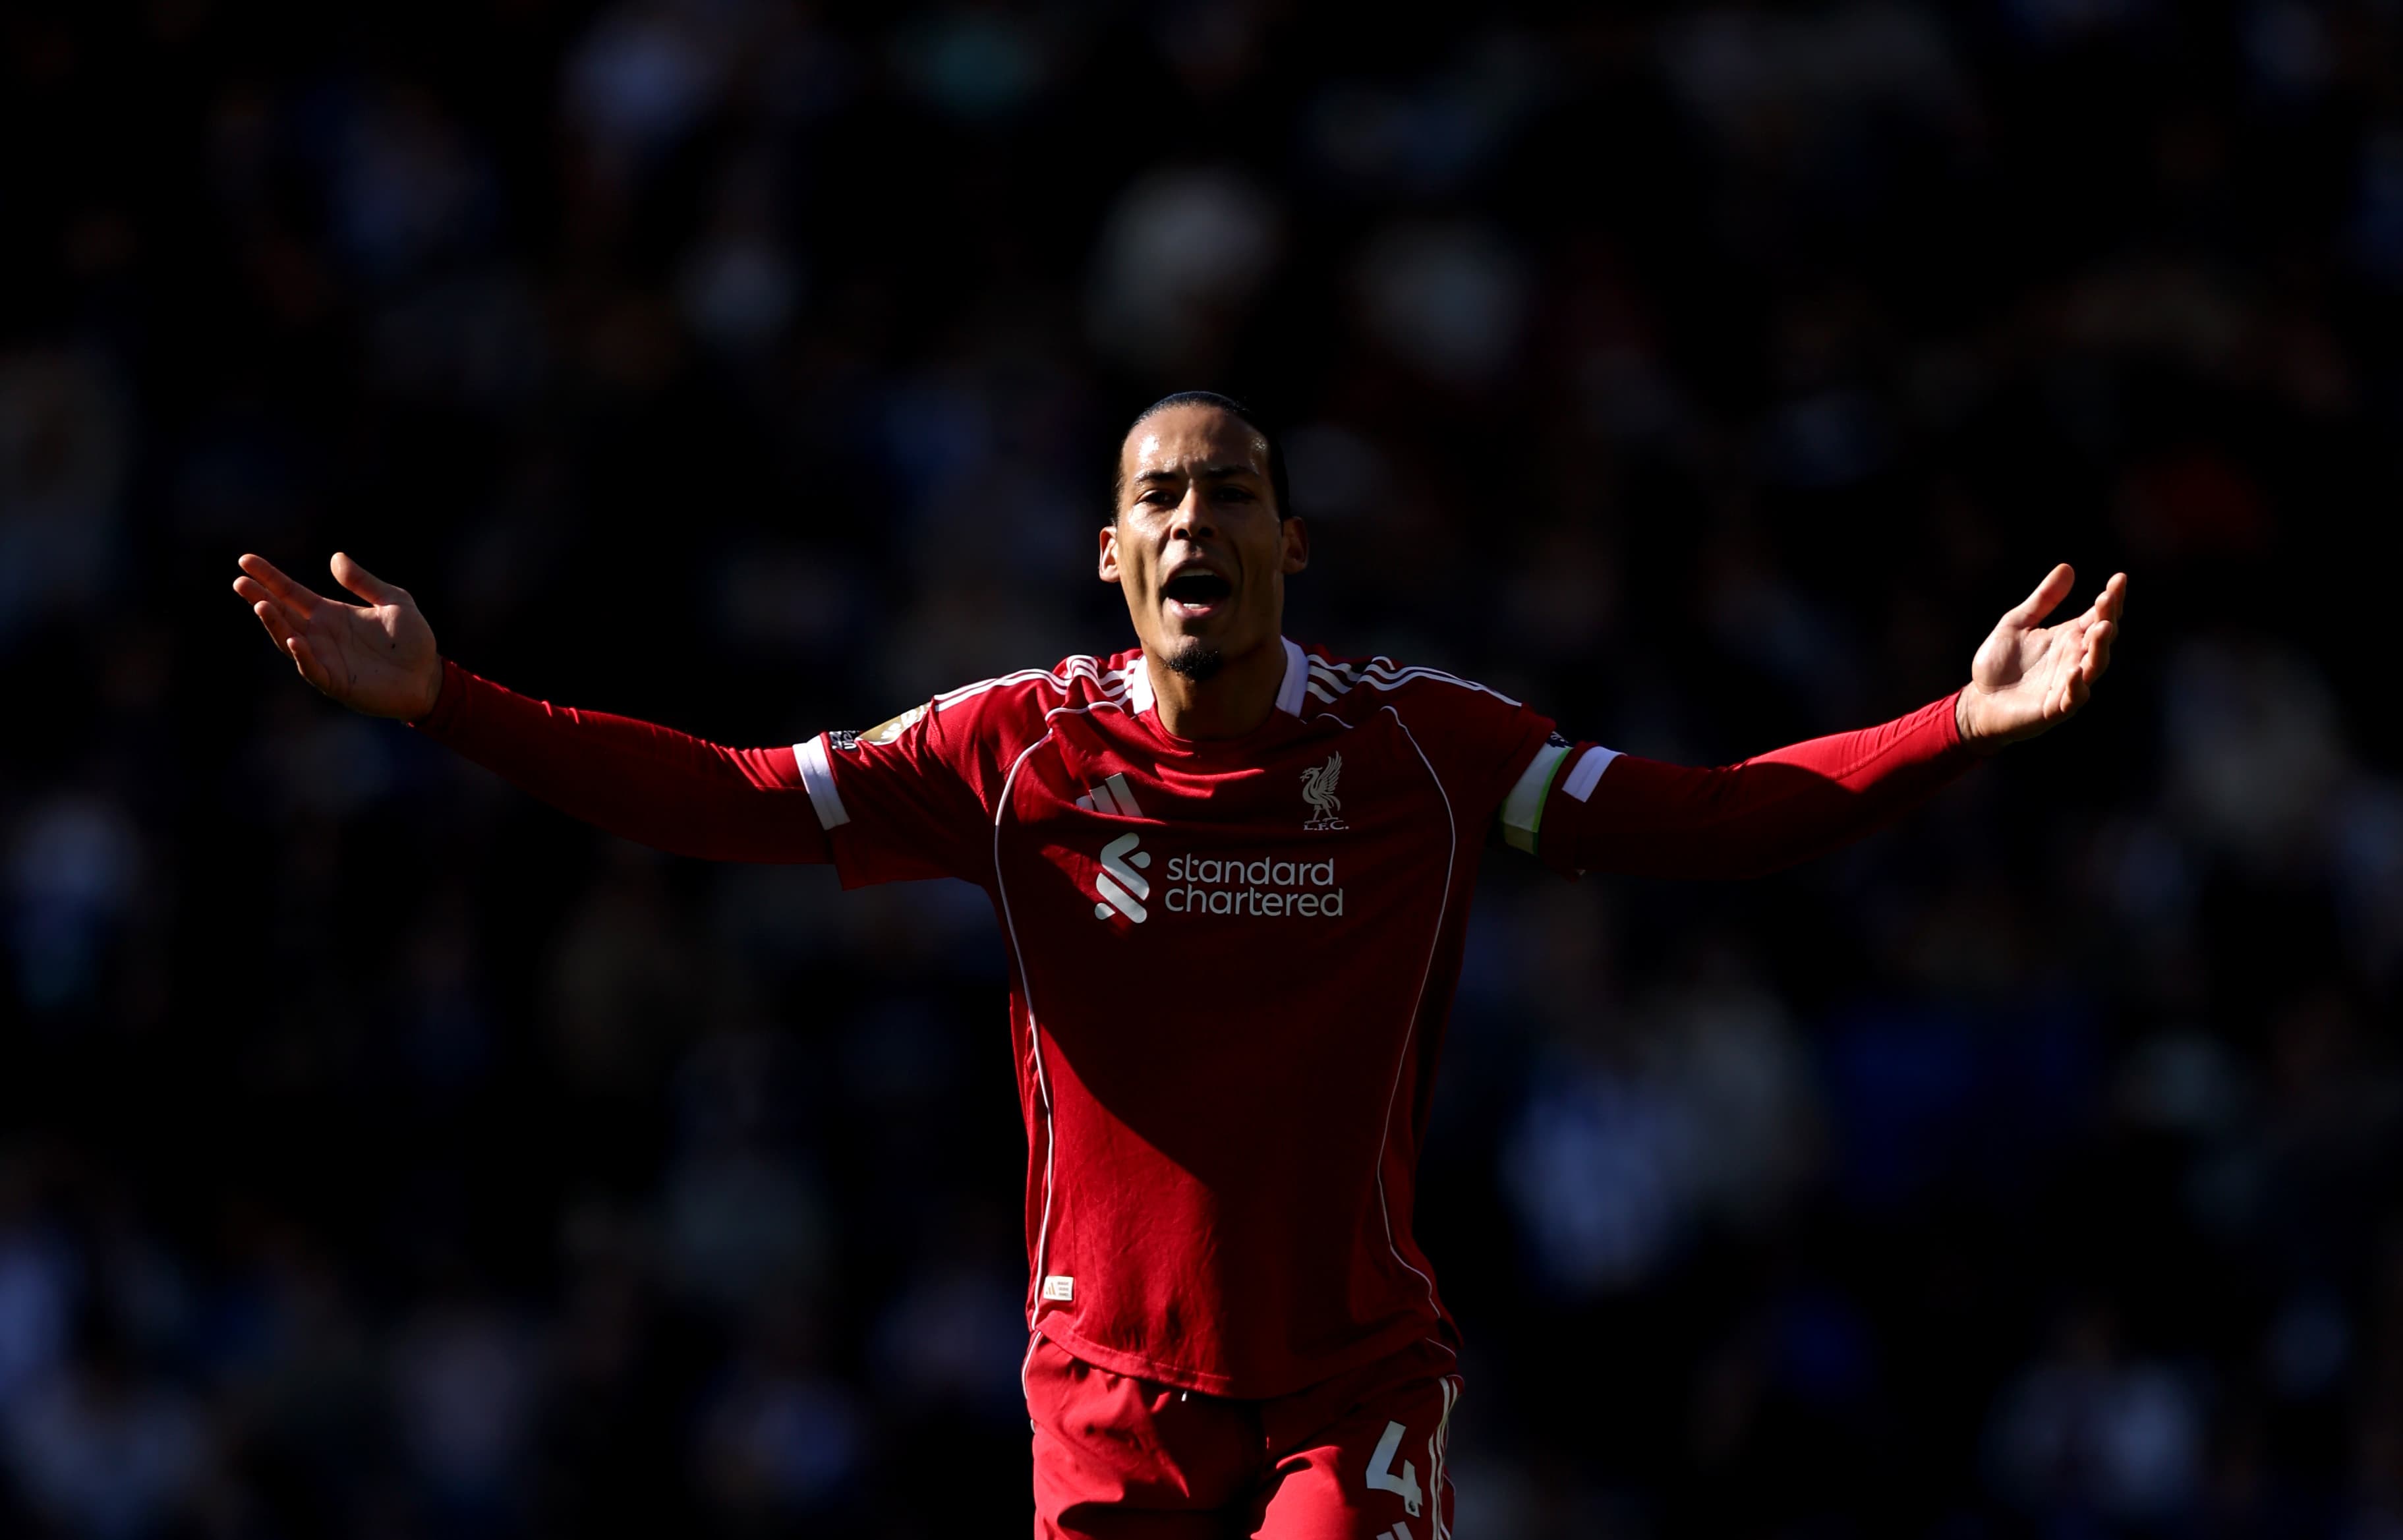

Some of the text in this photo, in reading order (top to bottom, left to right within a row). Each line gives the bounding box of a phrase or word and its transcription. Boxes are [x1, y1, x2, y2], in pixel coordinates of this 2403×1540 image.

[1304, 820, 1350, 830] L.F.C.
[1166, 853, 1335, 886] standard
[1165, 884, 1344, 917] chartered
[1365, 1420, 1423, 1518] 4
